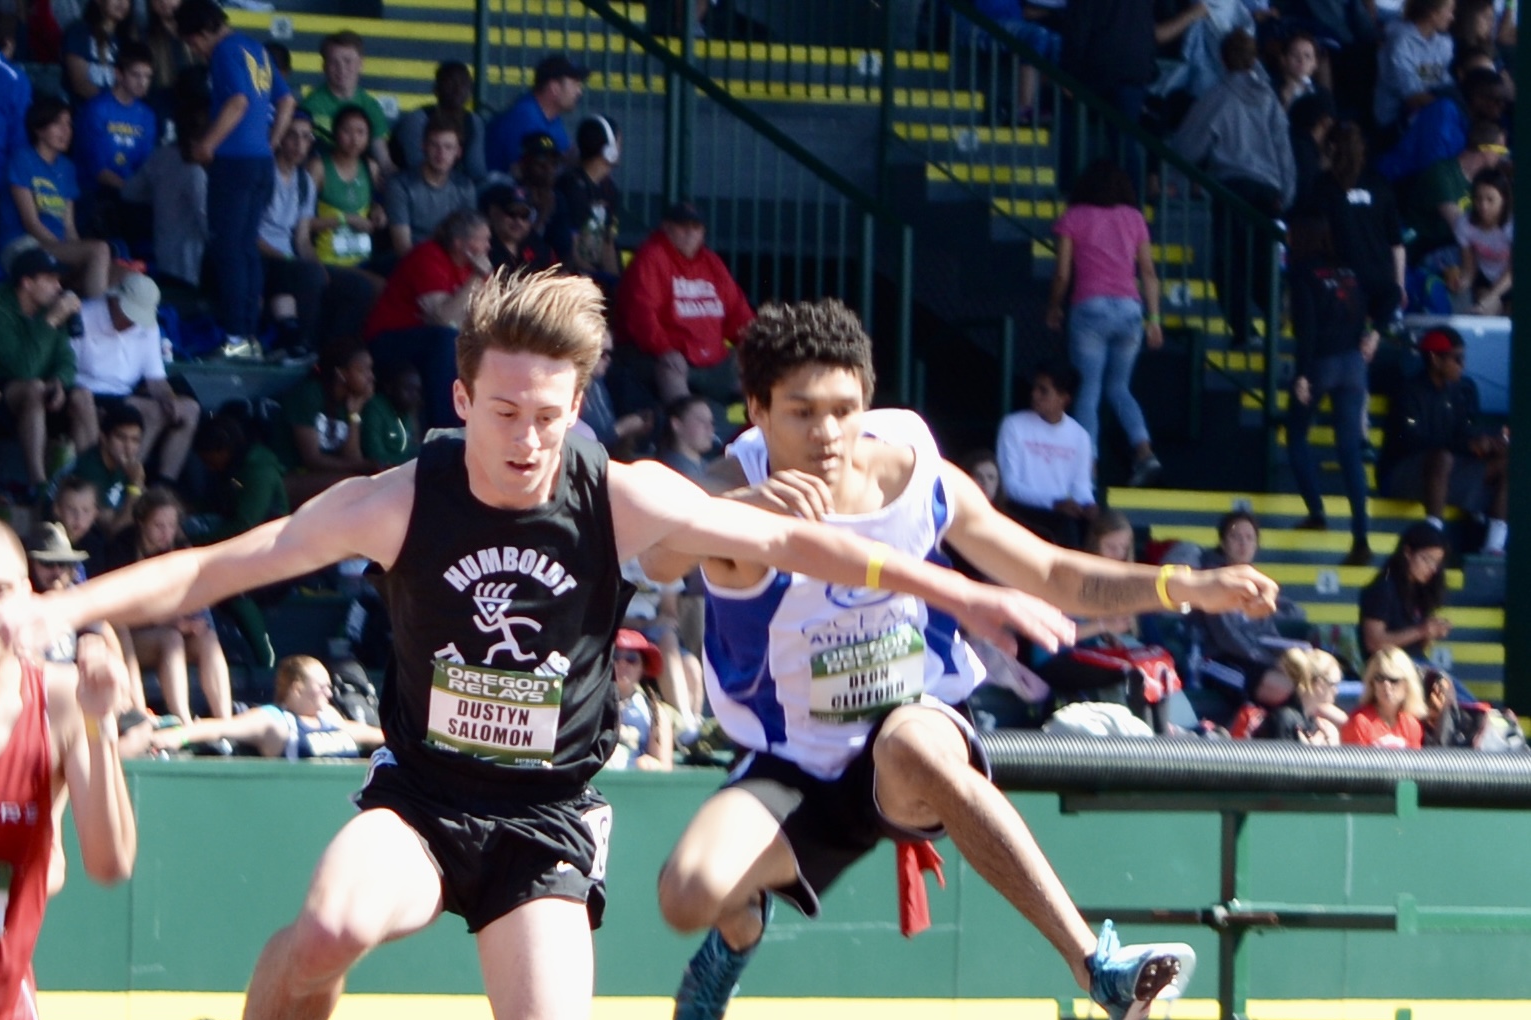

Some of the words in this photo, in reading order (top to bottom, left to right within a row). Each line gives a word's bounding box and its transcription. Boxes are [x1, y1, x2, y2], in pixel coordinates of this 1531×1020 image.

[443, 546, 578, 597] HUMBOLDT
[446, 666, 549, 692] OREGON
[448, 679, 545, 703] RELAYS
[457, 699, 530, 726] DUSTYN
[448, 718, 533, 747] SALOMON
